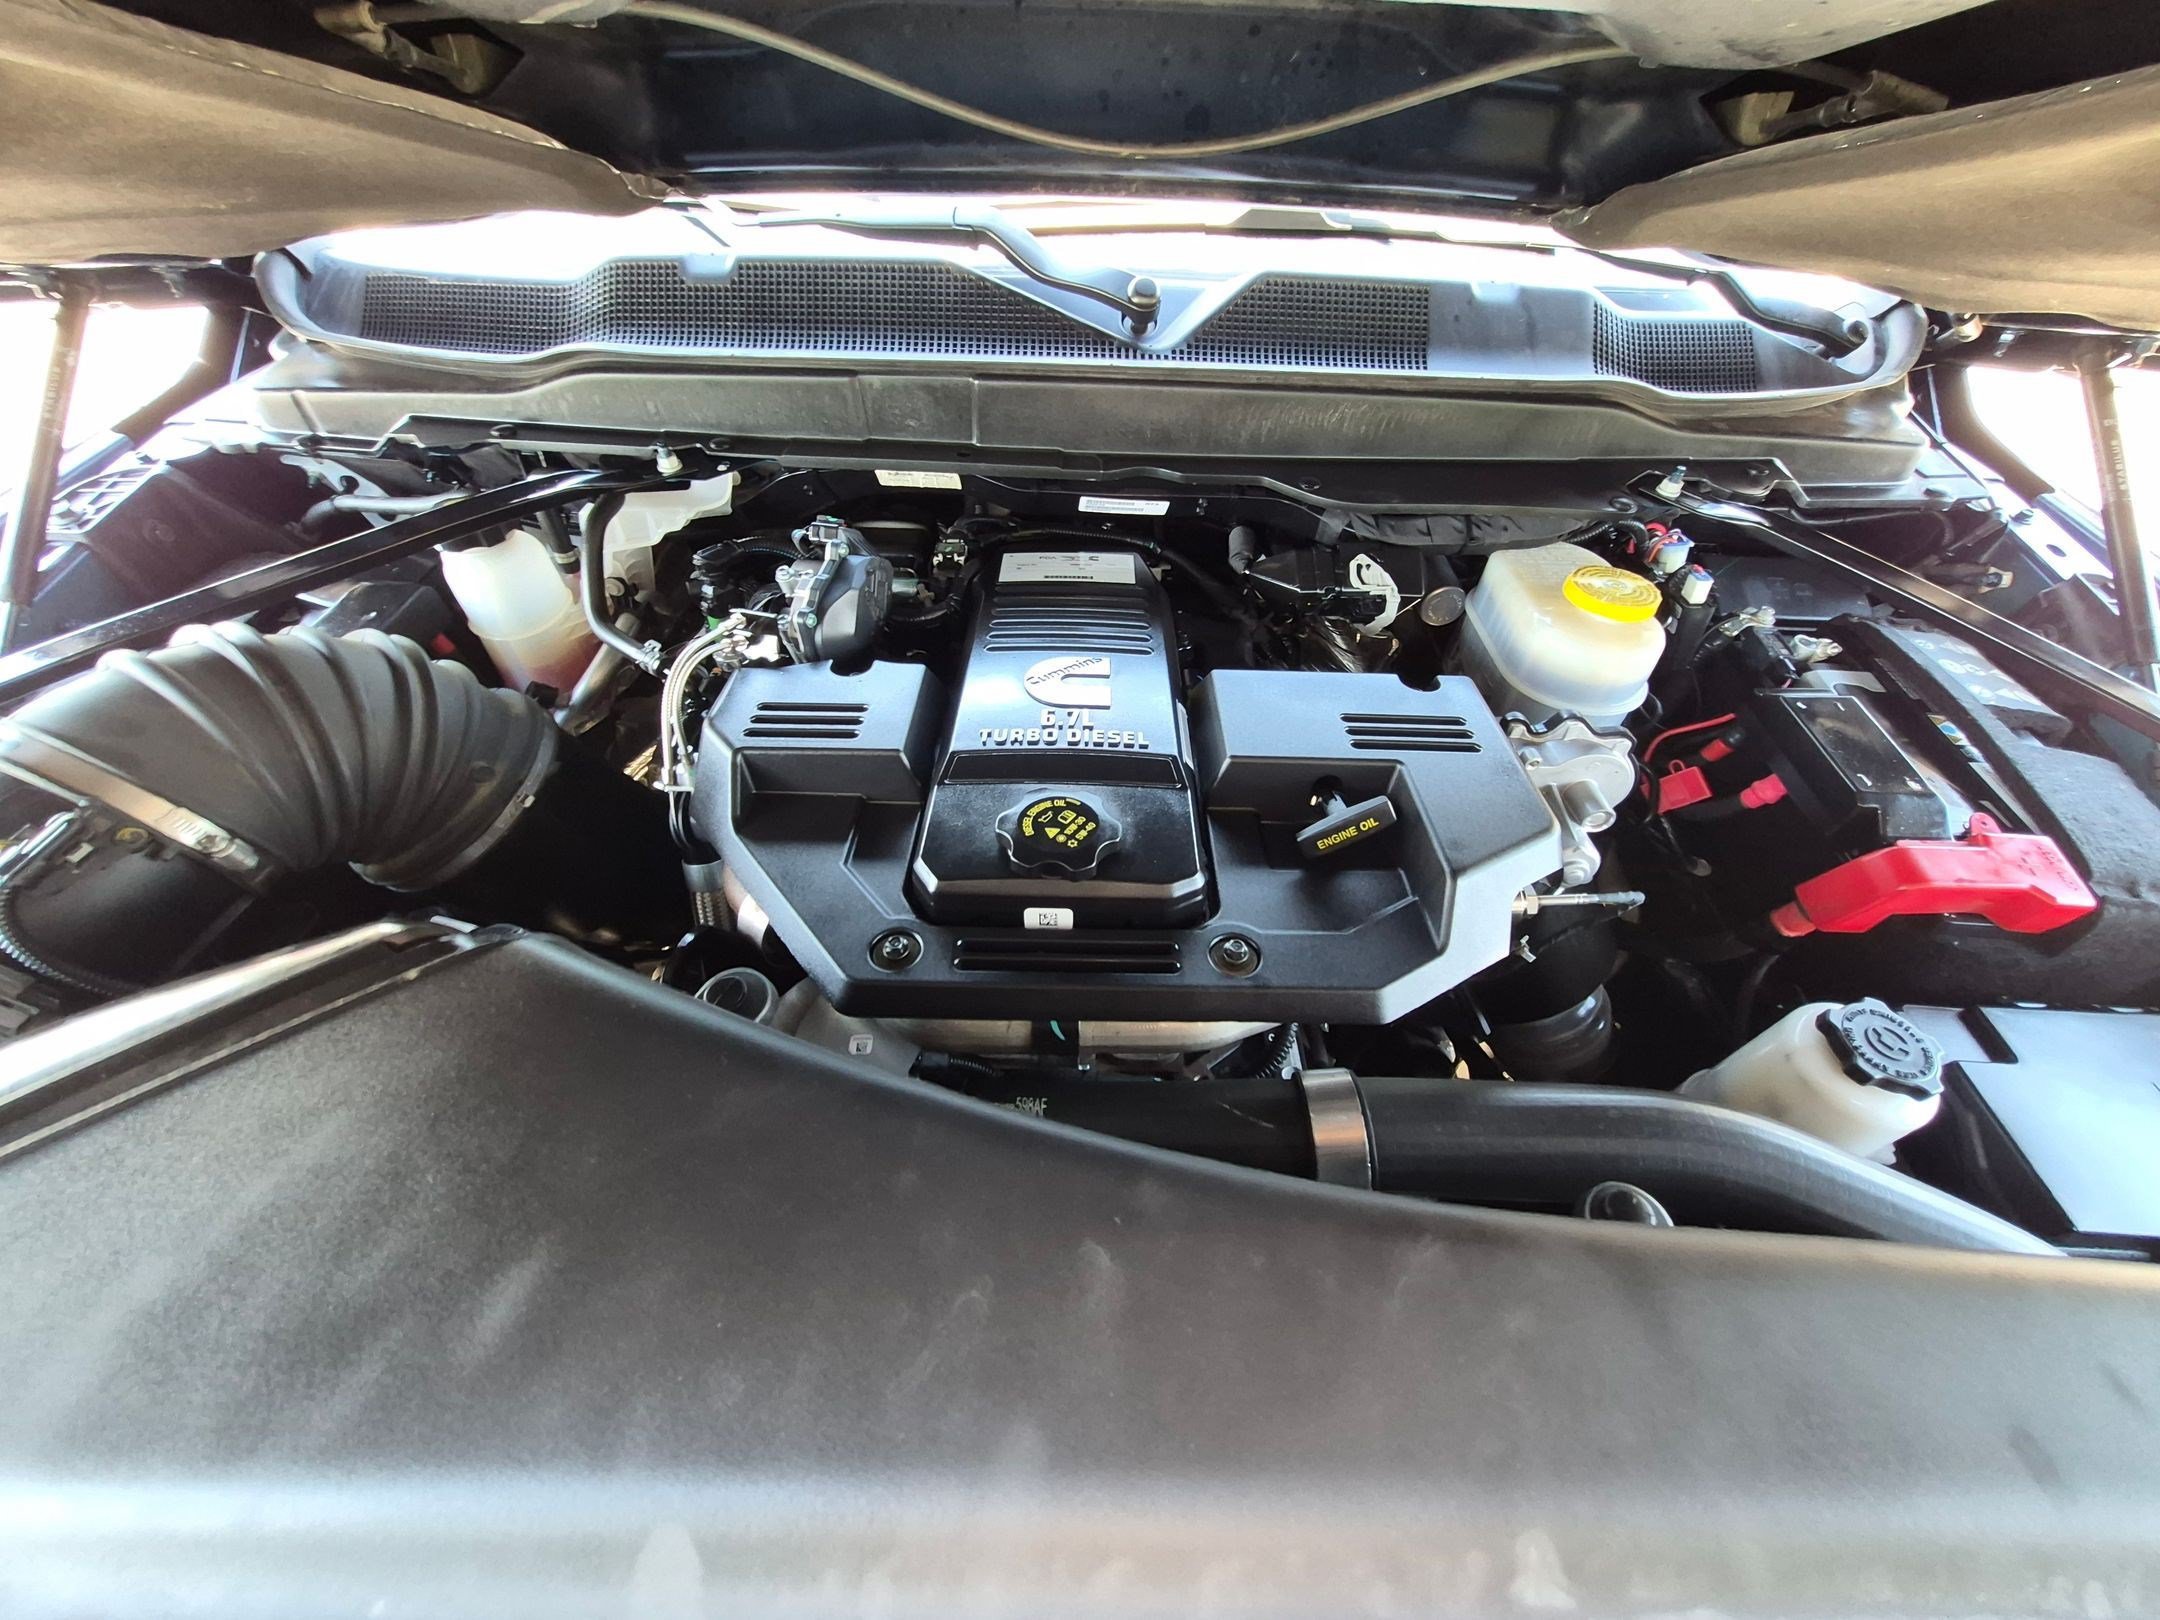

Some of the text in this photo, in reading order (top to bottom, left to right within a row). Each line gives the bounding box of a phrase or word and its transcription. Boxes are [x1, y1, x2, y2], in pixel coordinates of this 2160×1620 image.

[1026, 657, 1103, 685] Cummins
[1040, 708, 1094, 730] 6.7L
[979, 728, 1150, 749] TURBO DIESEL
[1053, 799, 1067, 807] OIL
[1316, 817, 1380, 850] ENGINE OIL
